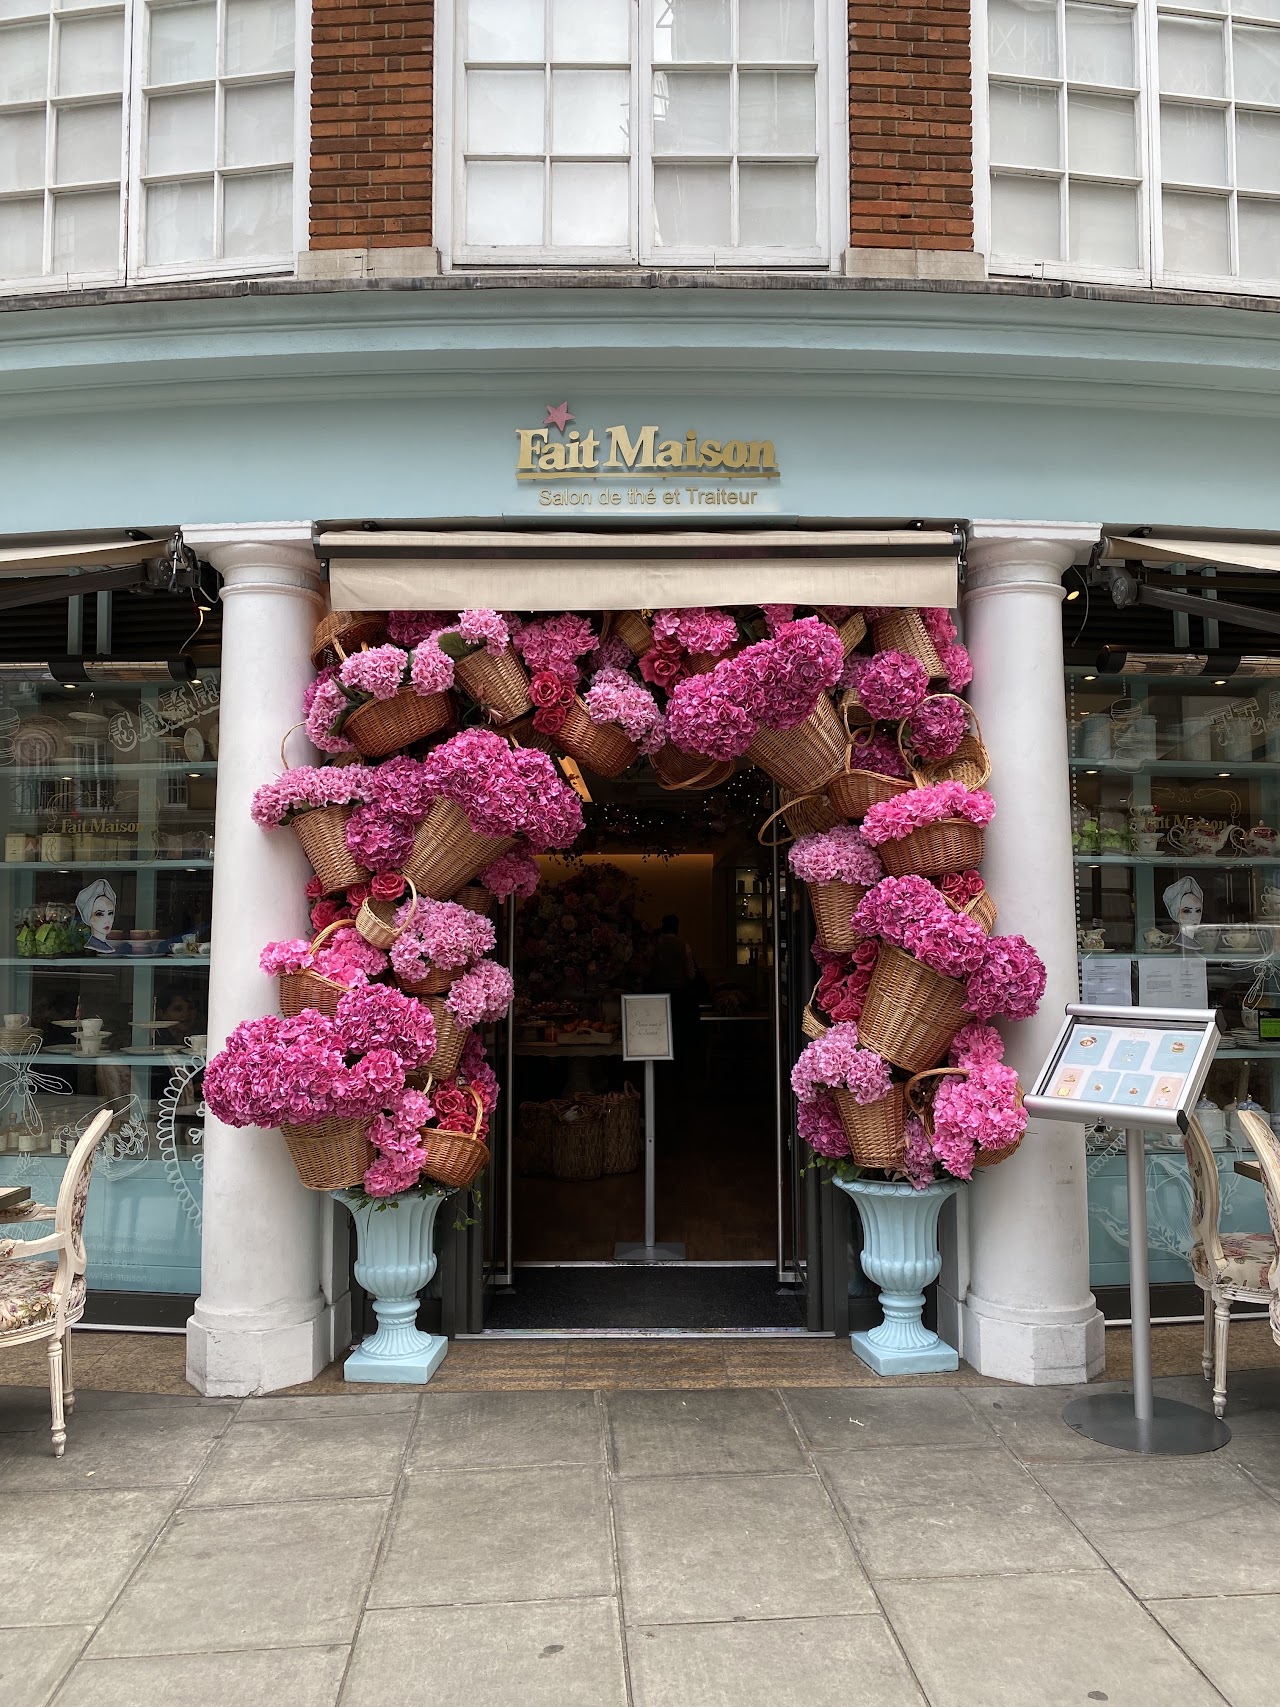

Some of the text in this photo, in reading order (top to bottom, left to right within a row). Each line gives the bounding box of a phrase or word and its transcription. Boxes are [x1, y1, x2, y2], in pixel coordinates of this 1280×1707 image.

[515, 425, 779, 470] Fait Maison
[539, 487, 758, 506] Salon de thé et Traiteur
[61, 818, 144, 833] Fait Maison
